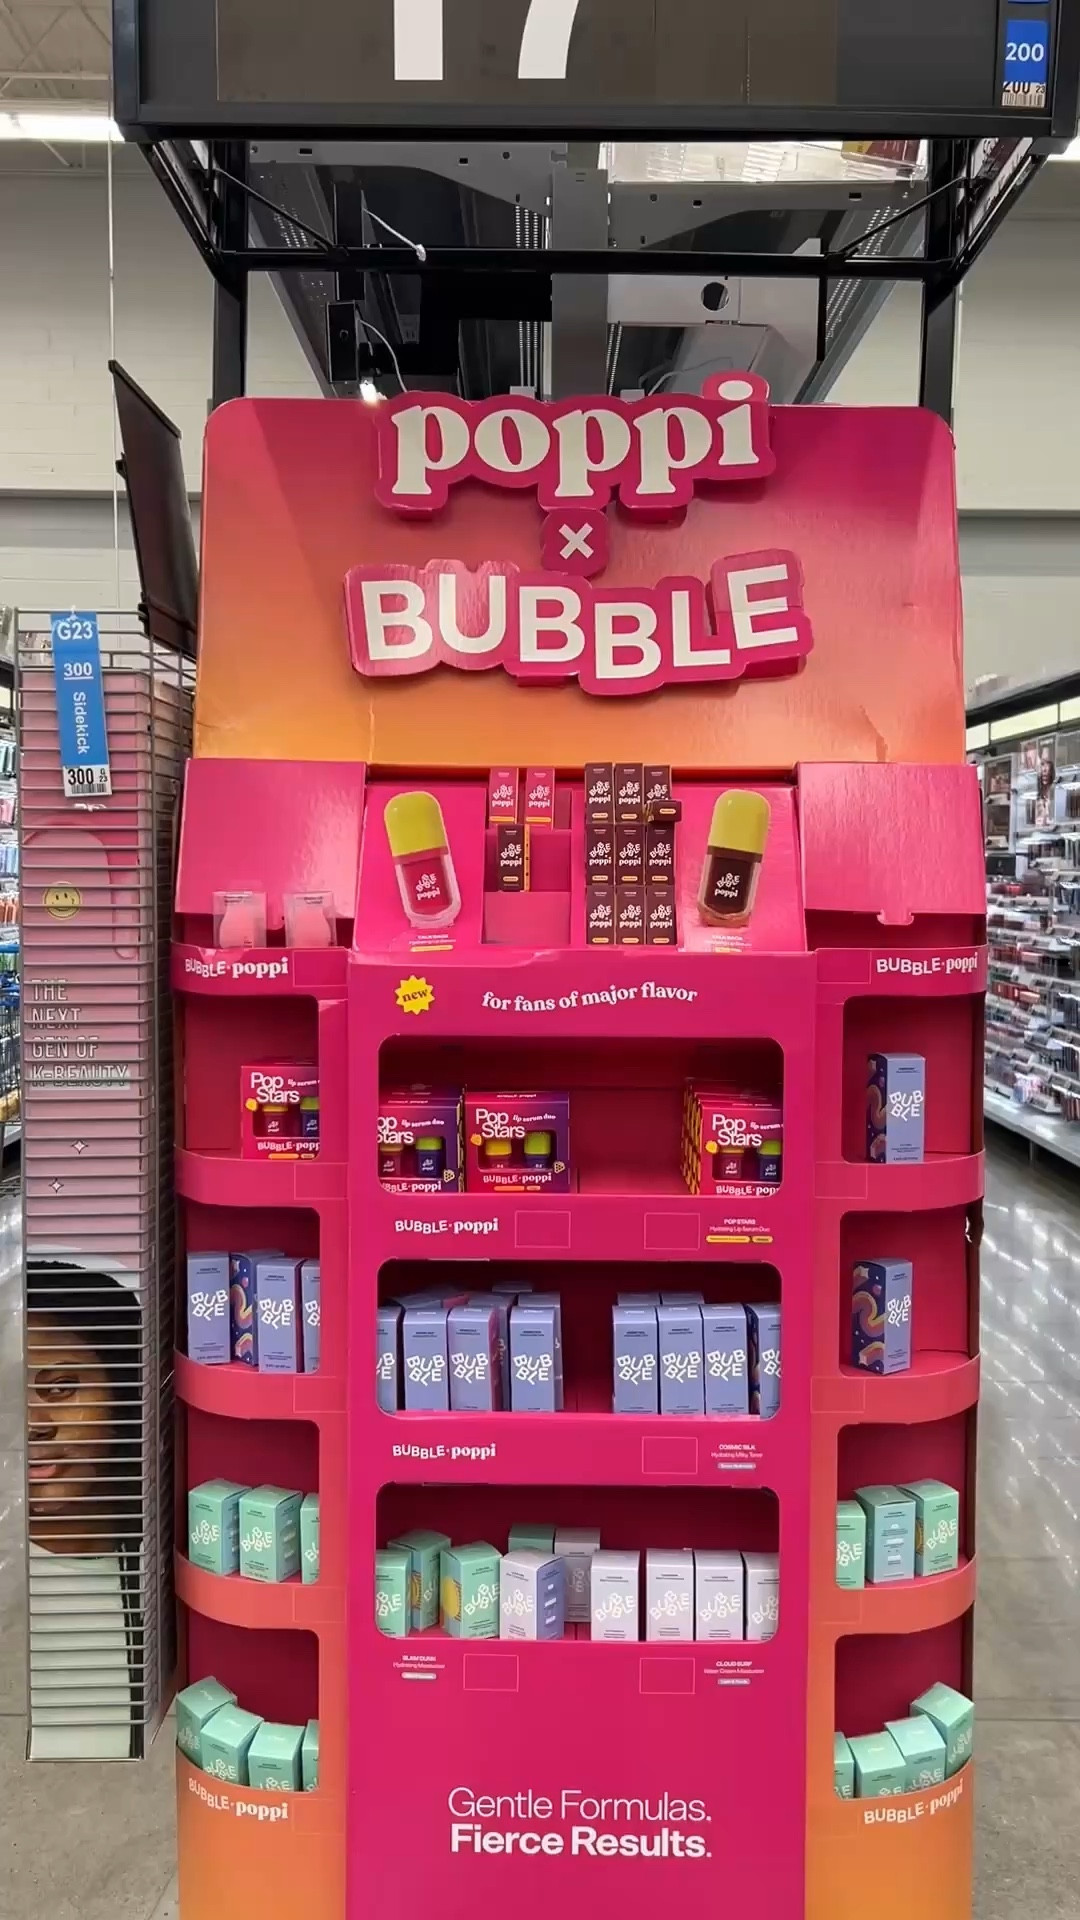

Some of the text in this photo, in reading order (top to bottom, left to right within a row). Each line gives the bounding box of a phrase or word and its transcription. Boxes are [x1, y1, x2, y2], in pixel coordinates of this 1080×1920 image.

[1005, 42, 1044, 62] 200
[391, 379, 760, 497] poppi
[57, 621, 93, 641] G23
[361, 564, 799, 680] BUBBLE
[63, 663, 93, 677] 300
[73, 691, 90, 755] Sidekick
[68, 768, 94, 785] 300
[31, 979, 68, 1001] THE
[402, 988, 427, 1002] new
[482, 982, 698, 1012] for fans of major flavor
[32, 1008, 80, 1029] NEXT
[32, 1037, 98, 1058] GEN OF
[33, 1065, 128, 1087] K-BEAUTY
[251, 1072, 284, 1092] Pop
[256, 1087, 300, 1103] Stars
[889, 1090, 924, 1121] BUBBLE
[377, 1117, 397, 1133] op
[476, 1108, 509, 1128] Pop
[482, 1122, 525, 1138] Stars
[712, 1114, 746, 1137] Pop
[718, 1130, 762, 1146] Stars
[191, 1290, 228, 1321] BUBBLE
[259, 1298, 294, 1329] BUBBLE
[887, 1295, 911, 1327] BUBBLE
[406, 1354, 445, 1386] BUBBLE
[451, 1352, 488, 1384] BUBBLE
[513, 1354, 552, 1385] BUBBLE
[617, 1353, 656, 1385] BUBBLE
[662, 1351, 701, 1383] BUBBLE
[707, 1349, 746, 1381] BUBBLE
[191, 1520, 220, 1544] BUBBLE
[241, 1527, 272, 1552] BUBBLE
[927, 1519, 957, 1550] BUBBLE
[595, 1592, 636, 1622] BUBBLE
[650, 1590, 690, 1620] BUBBLE
[700, 1592, 741, 1621] BUBBLE
[448, 1787, 712, 1821] Gentle Formulas.
[451, 1824, 712, 1857] Fierce Results.
